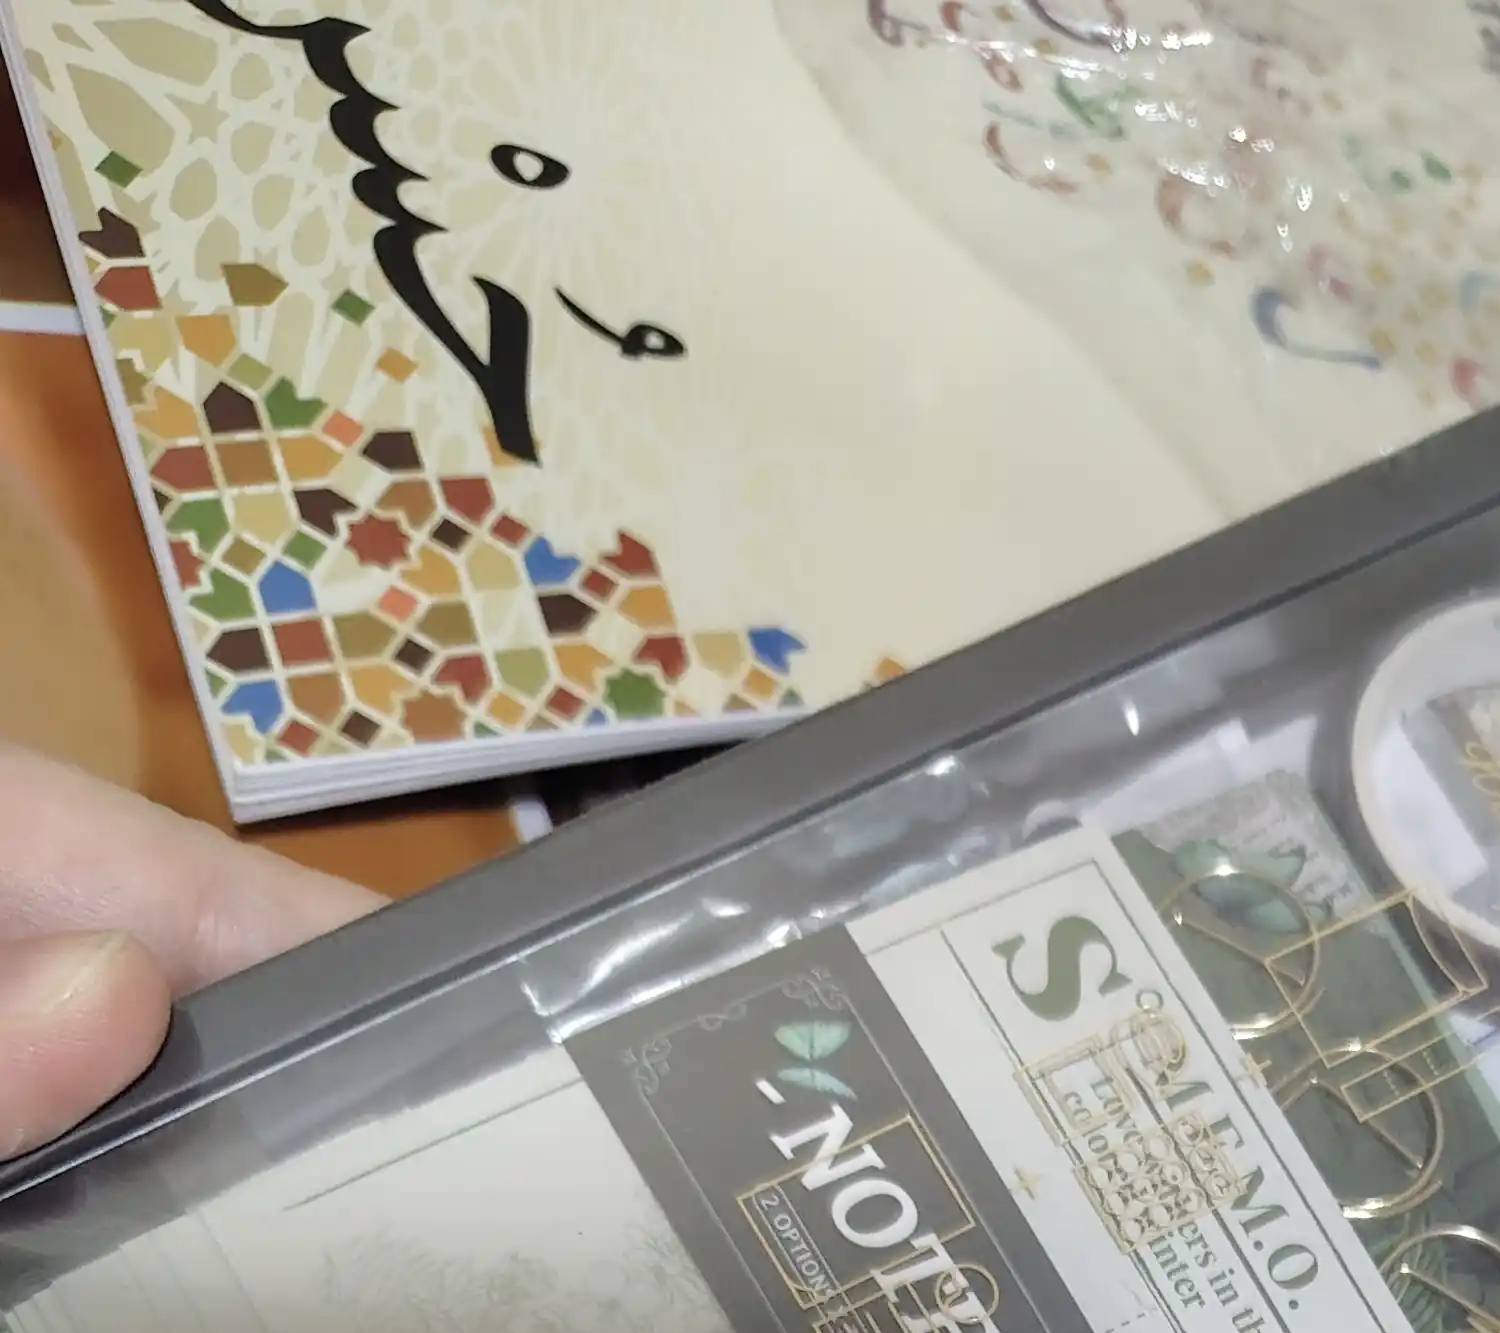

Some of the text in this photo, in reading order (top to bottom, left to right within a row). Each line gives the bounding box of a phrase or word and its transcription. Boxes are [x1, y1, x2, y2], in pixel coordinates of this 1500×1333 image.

[760, 1192, 781, 1211] 2
[1088, 1073, 1152, 1156] Love
[1208, 1268, 1238, 1306] in
[770, 1209, 836, 1303] OPTIONS
